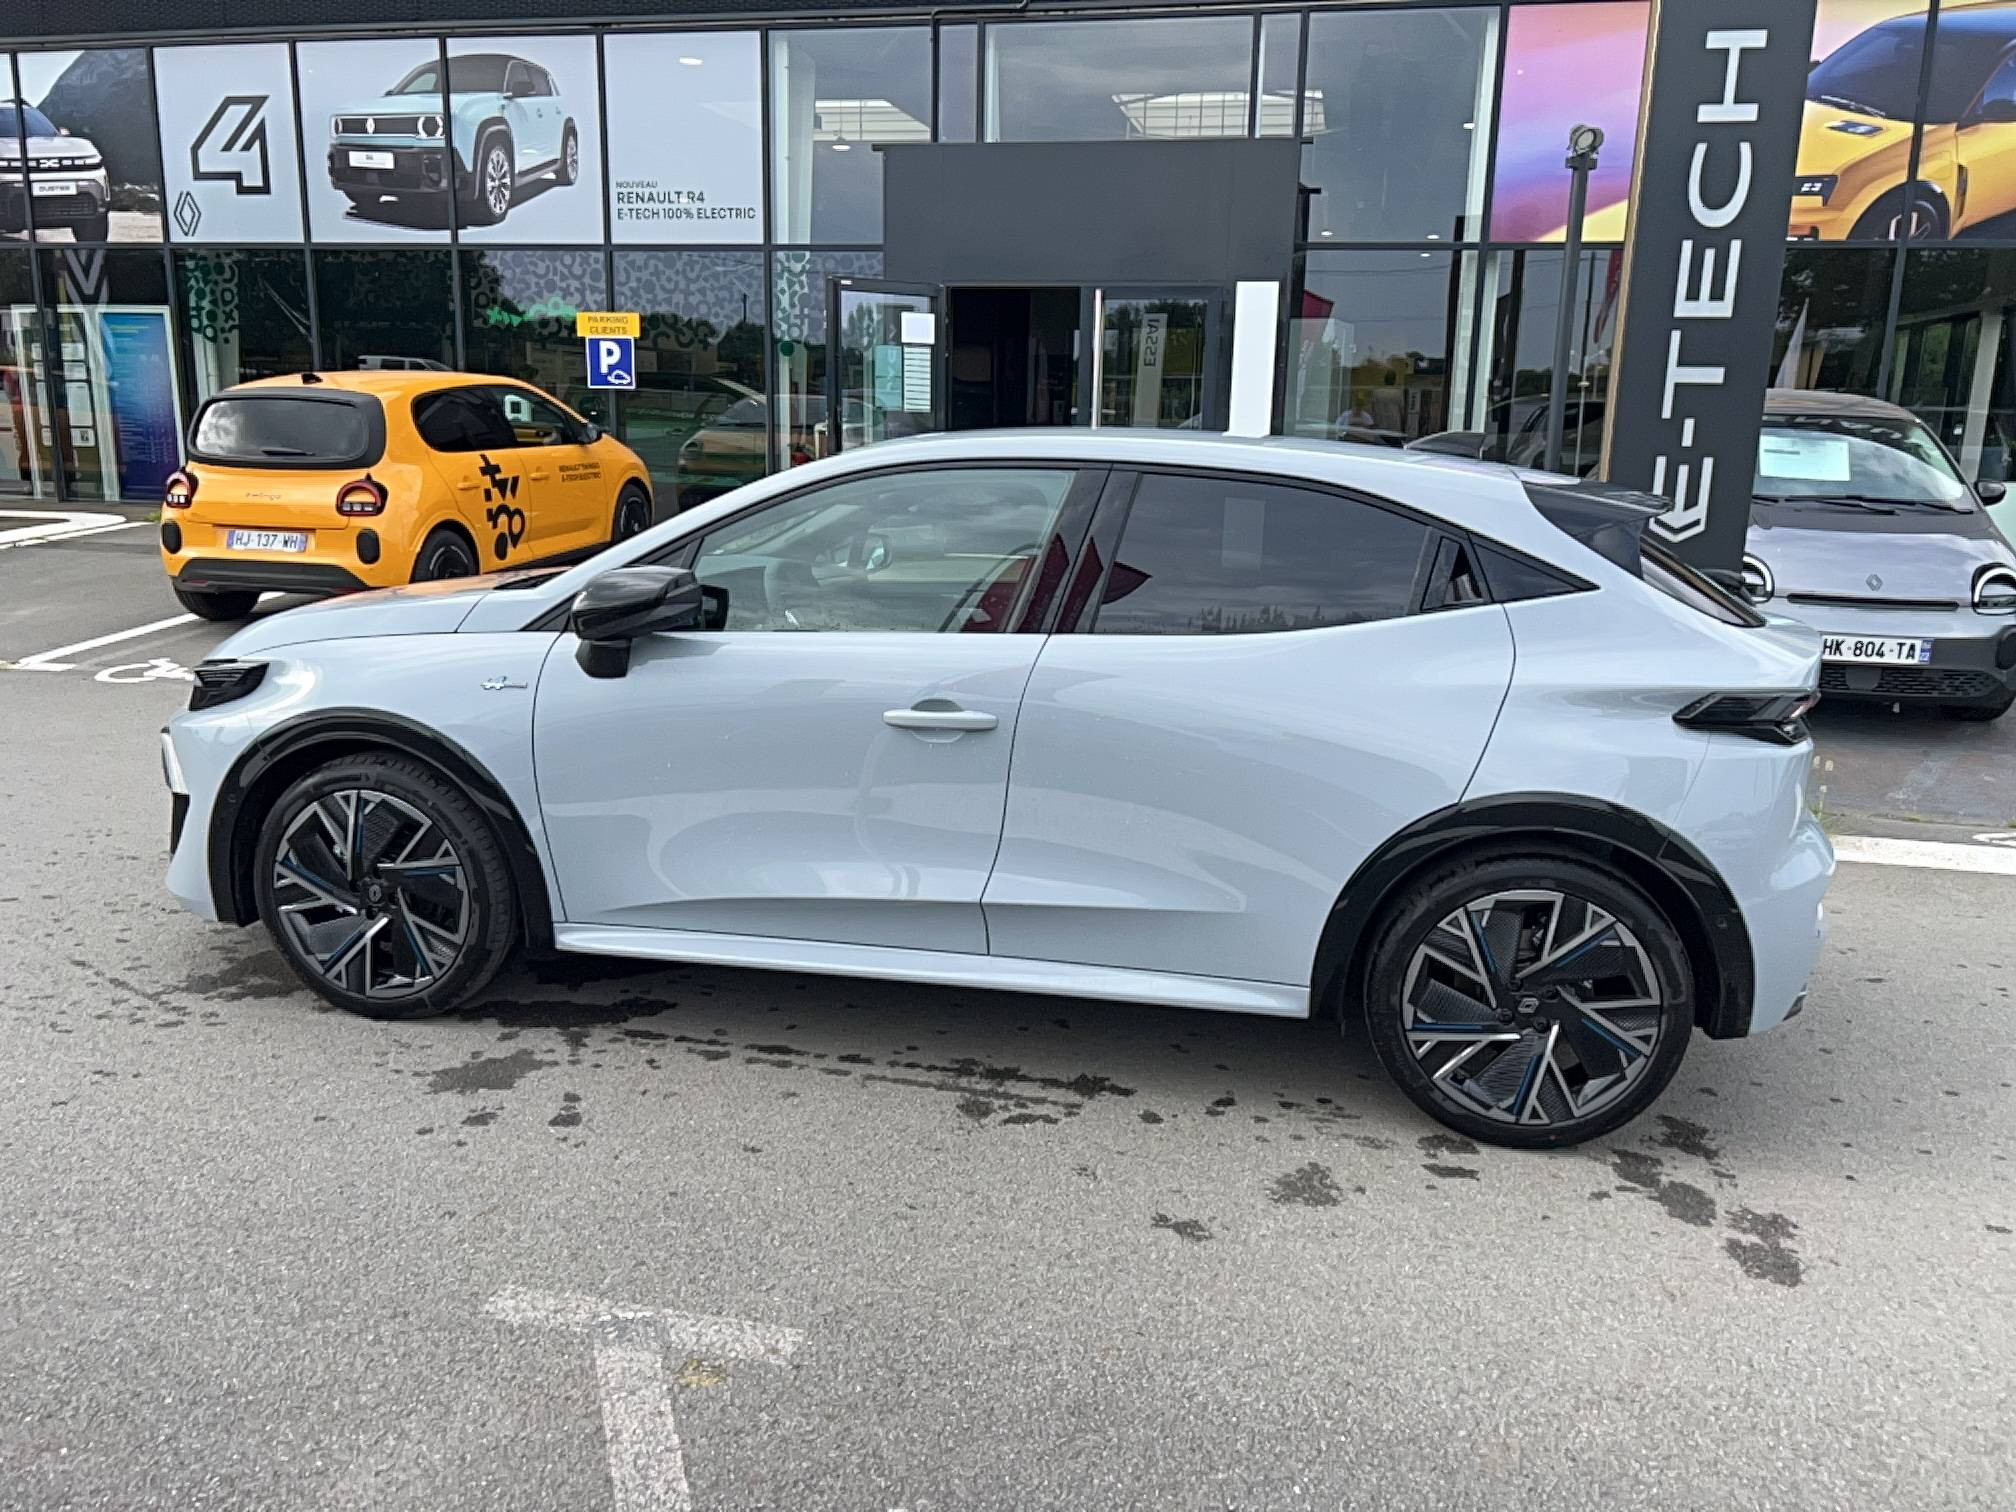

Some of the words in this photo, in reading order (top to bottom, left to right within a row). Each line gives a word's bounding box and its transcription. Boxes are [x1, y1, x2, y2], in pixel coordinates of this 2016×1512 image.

[190, 95, 272, 195] 4
[615, 181, 658, 189] NOUVEAU
[617, 191, 683, 204] RENAULT
[687, 191, 705, 204] R4
[617, 208, 659, 220] E-TECH
[663, 208, 694, 219] 100%
[697, 207, 756, 219] ELECTRIC
[1648, 28, 1768, 543] E-TECH
[587, 316, 628, 325] PARKING
[589, 326, 628, 335] CLIENTS
[599, 340, 621, 374] P
[1822, 638, 1917, 660] HK-804-TA
